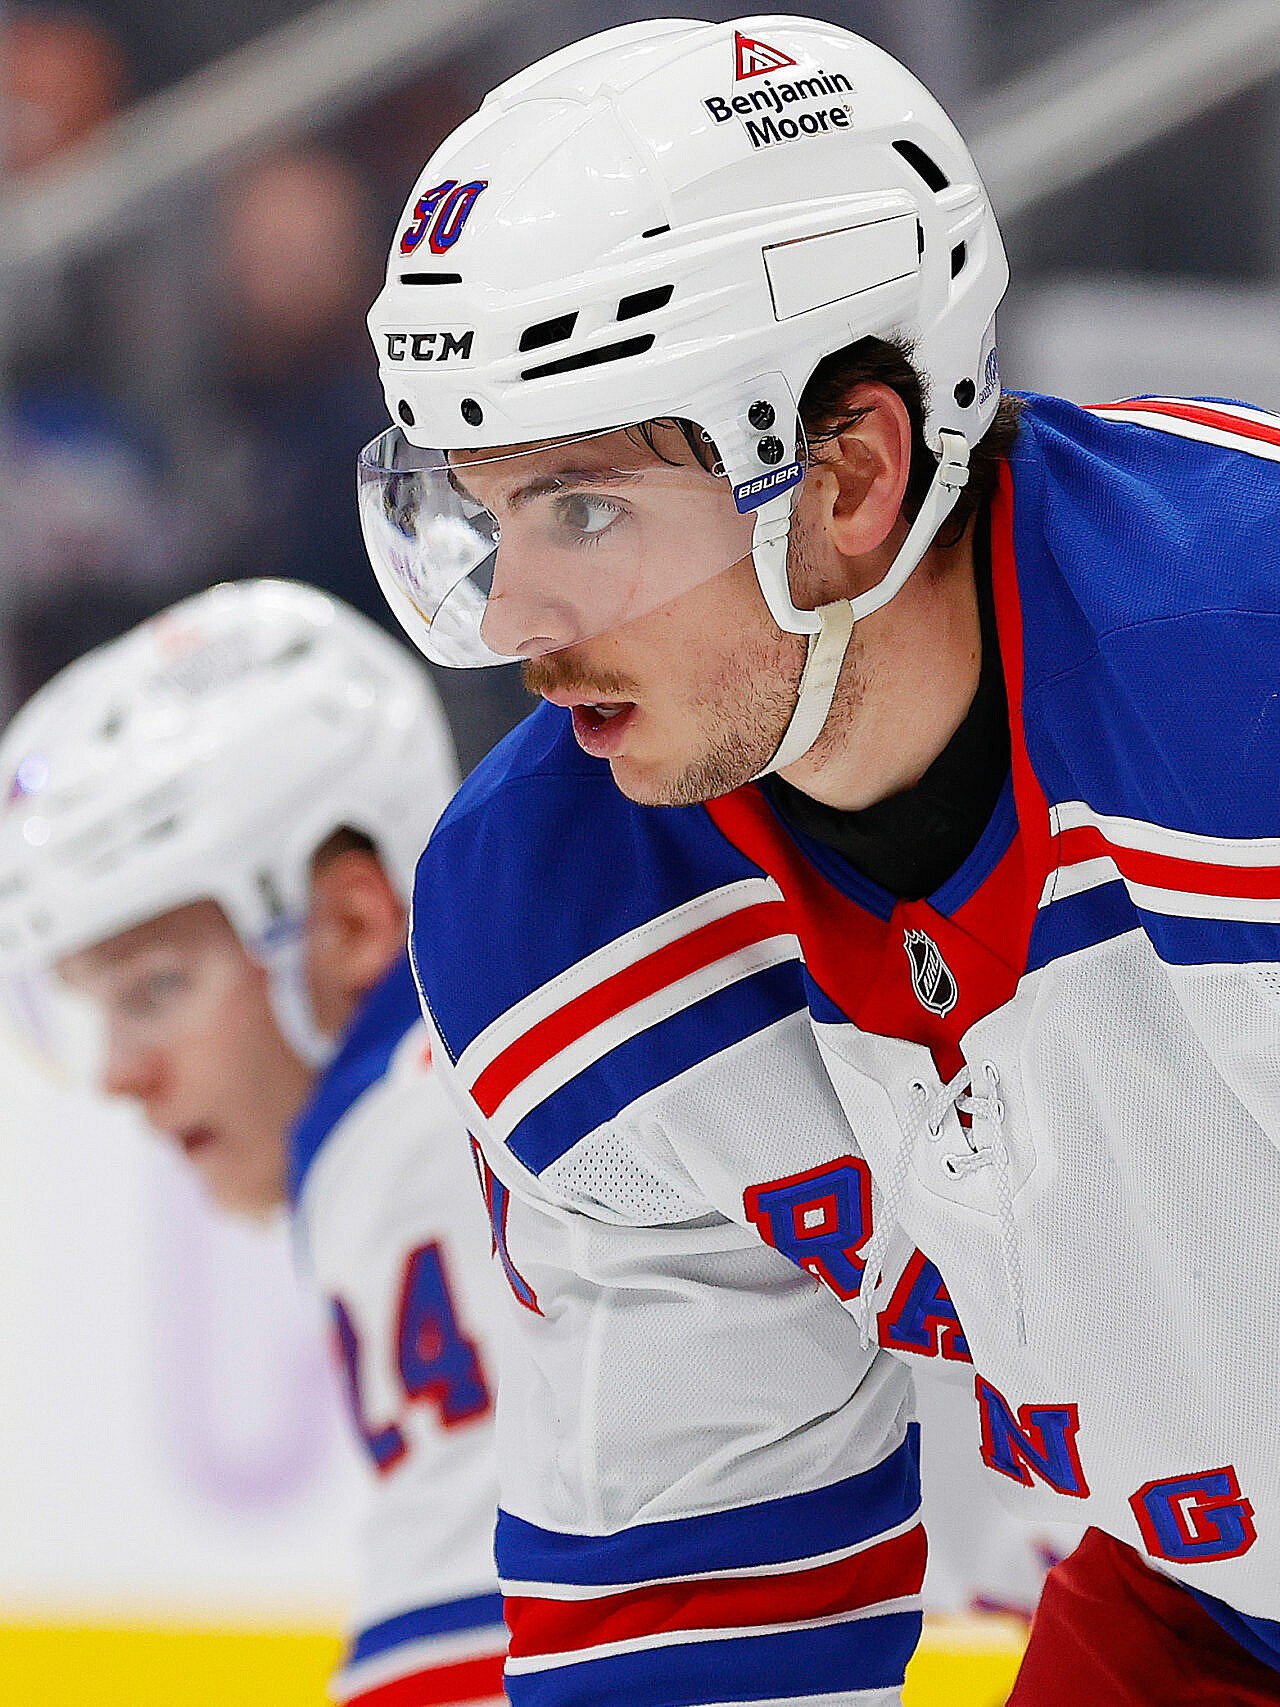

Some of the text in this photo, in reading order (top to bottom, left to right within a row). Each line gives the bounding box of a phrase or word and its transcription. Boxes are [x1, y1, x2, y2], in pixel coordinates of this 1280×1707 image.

[704, 70, 854, 123] Benjamin
[400, 180, 489, 255] 90
[384, 331, 475, 362] CCM
[738, 465, 800, 499] BAUER
